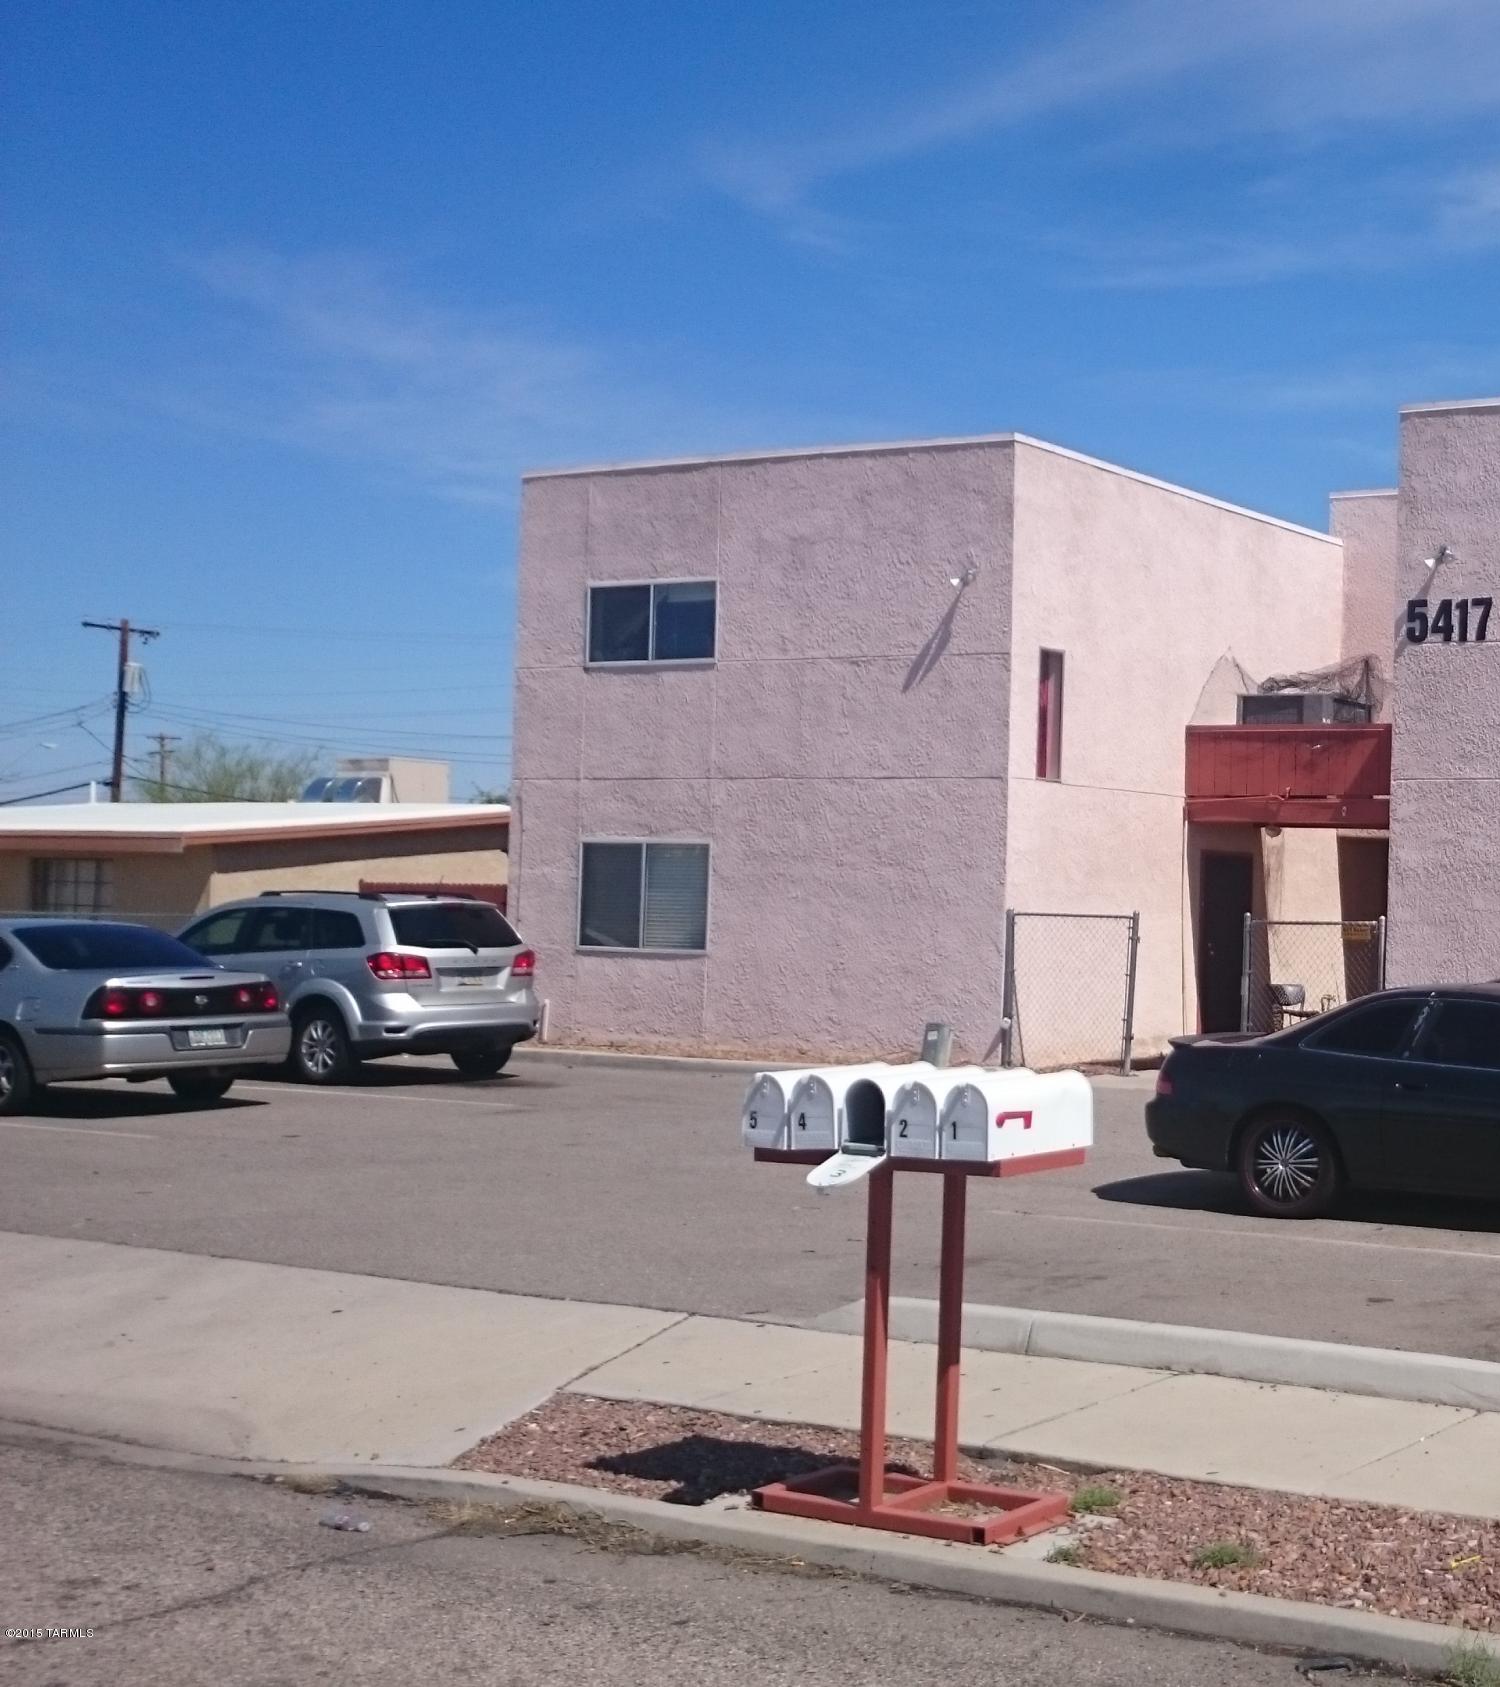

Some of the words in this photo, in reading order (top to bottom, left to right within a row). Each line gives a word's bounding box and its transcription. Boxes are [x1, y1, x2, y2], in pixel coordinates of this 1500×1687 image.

[1406, 597, 1493, 643] 5417
[749, 1110, 758, 1129] 5
[798, 1112, 807, 1130] 4
[899, 1119, 908, 1138] 2
[951, 1121, 957, 1140] 1
